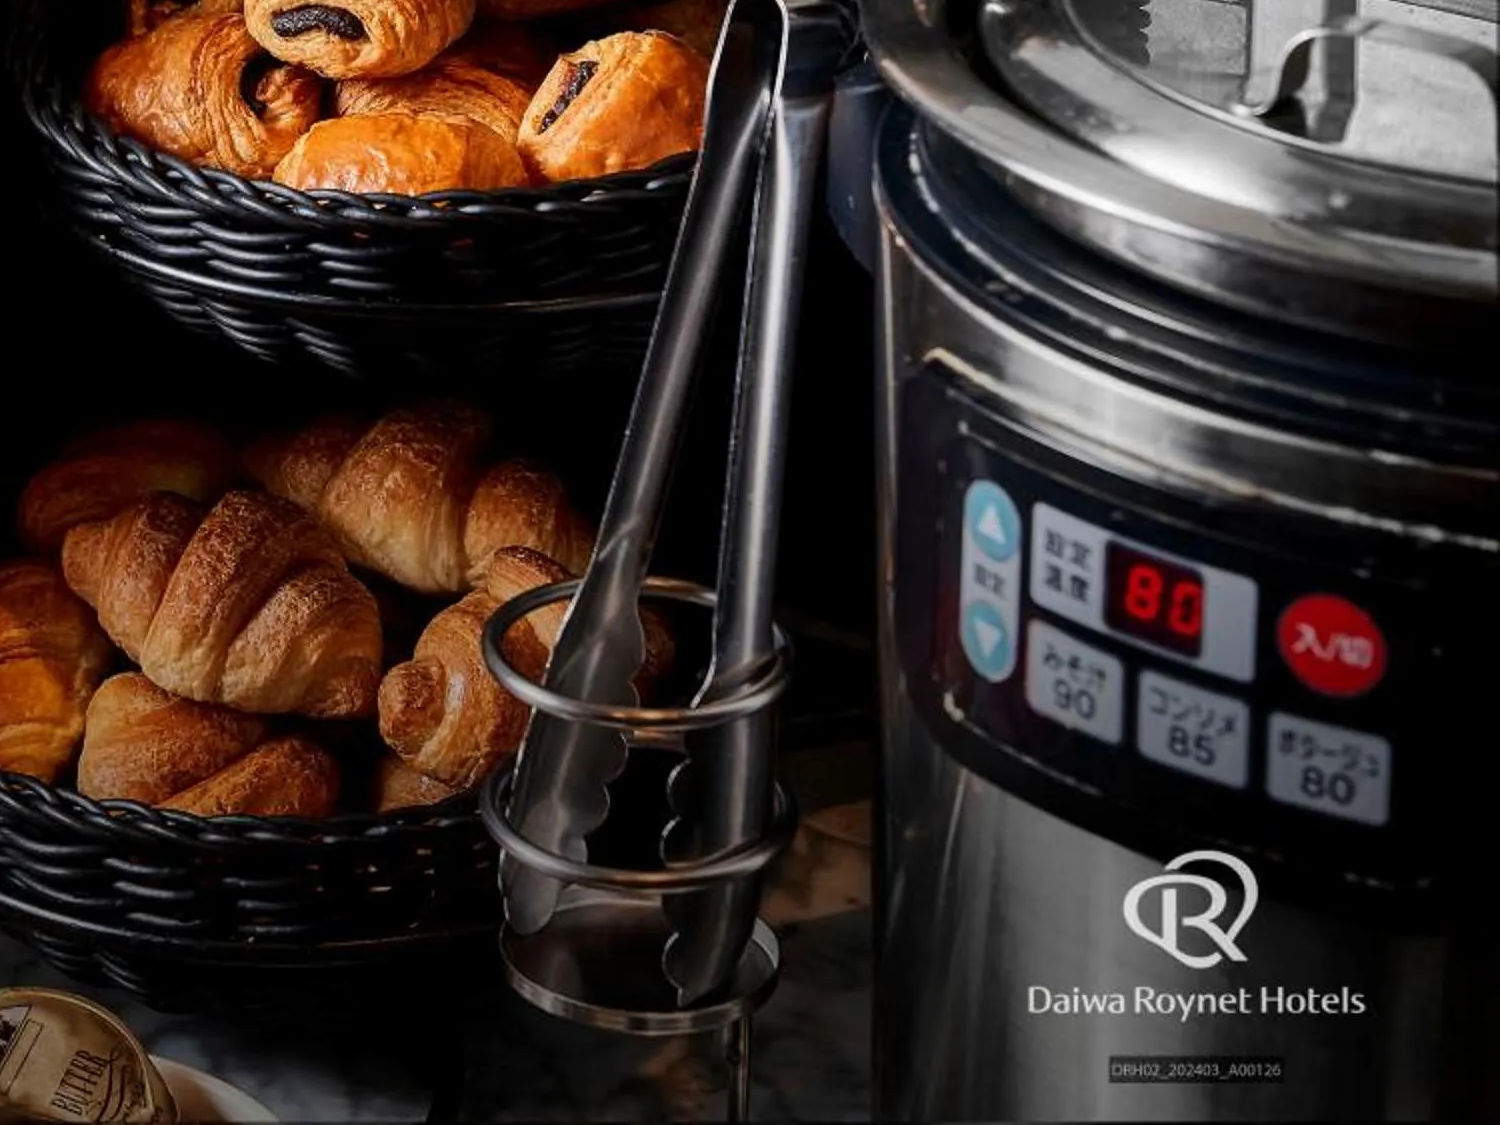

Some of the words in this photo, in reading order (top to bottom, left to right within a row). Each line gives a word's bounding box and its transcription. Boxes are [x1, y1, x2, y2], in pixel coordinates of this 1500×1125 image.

[1124, 565, 1205, 636] 80
[1053, 679, 1097, 721] 90
[1149, 685, 1238, 737] コンソメ
[1167, 725, 1216, 768] 85
[1301, 765, 1357, 807] 80
[51, 1049, 110, 1116] BUTTER
